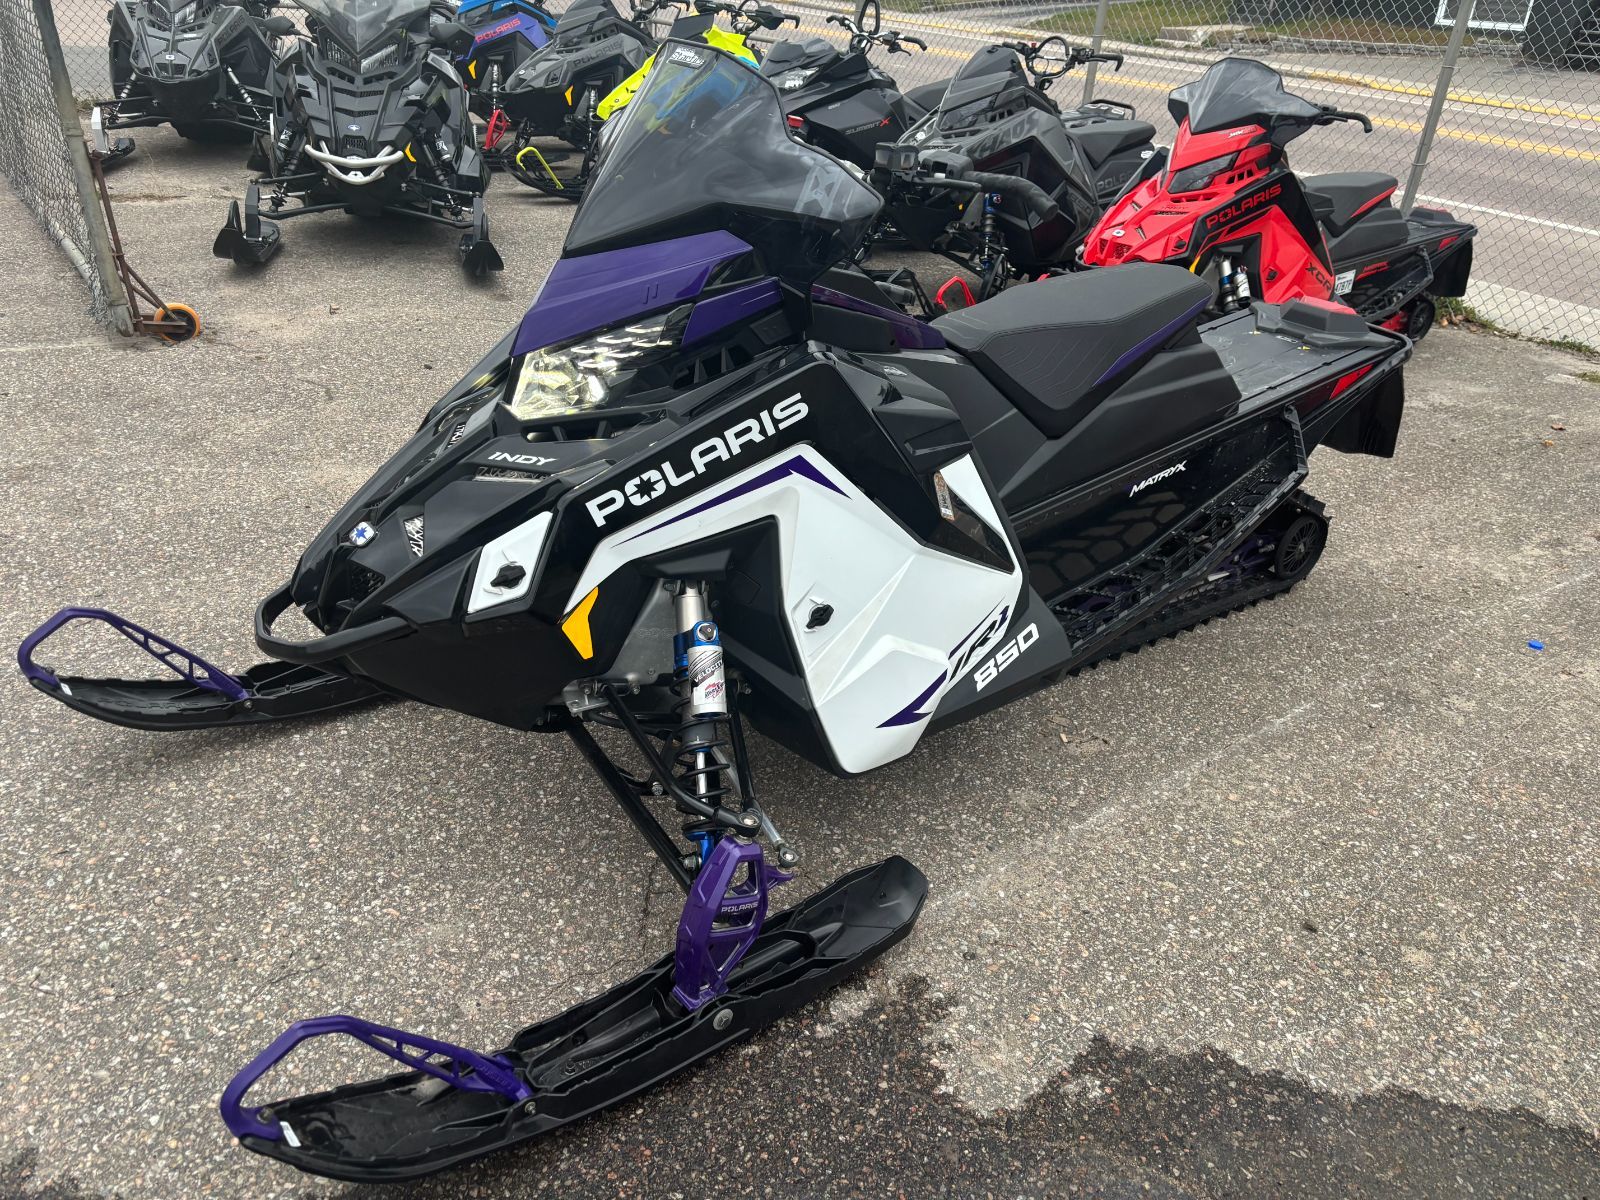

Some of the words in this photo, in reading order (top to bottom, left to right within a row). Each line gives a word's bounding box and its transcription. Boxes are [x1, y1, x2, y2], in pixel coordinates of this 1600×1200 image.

[475, 18, 521, 43] POLARIS
[573, 39, 624, 68] POLARIS
[1205, 184, 1282, 229] POLARIS
[1305, 262, 1332, 291] XCR
[488, 451, 558, 466] INDY
[585, 393, 809, 528] POLARIS
[1129, 460, 1187, 498] MATRYX
[973, 622, 1040, 692] 850
[694, 661, 722, 683] VELOCIT
[721, 901, 759, 913] POLARIS
